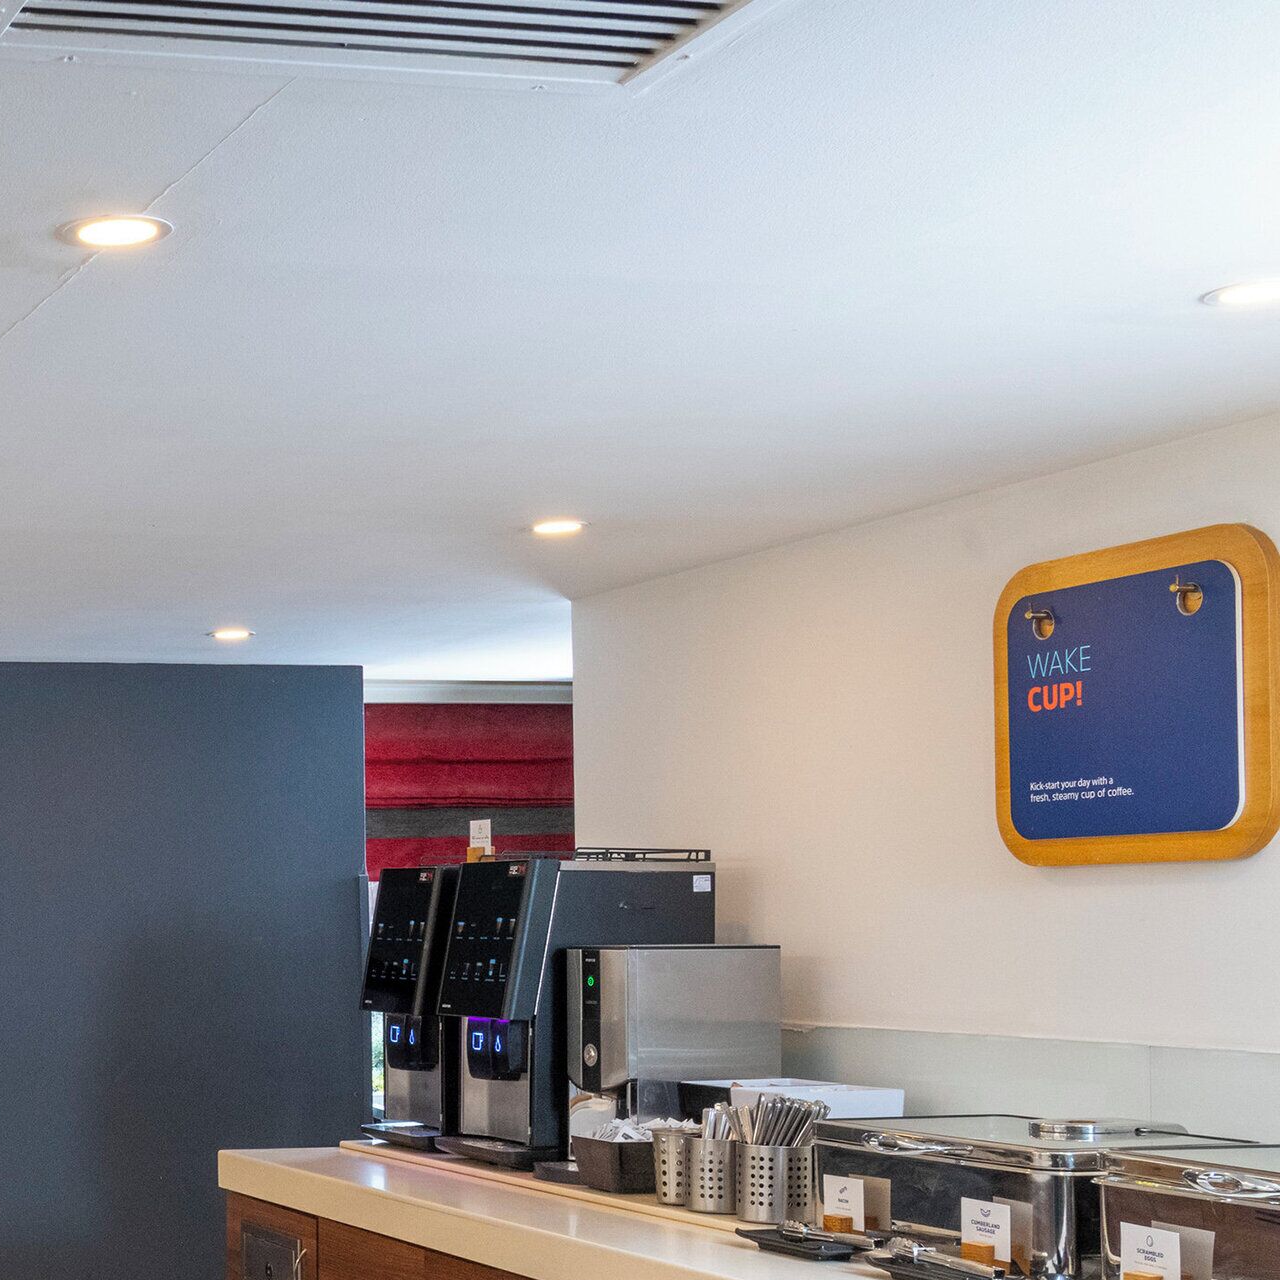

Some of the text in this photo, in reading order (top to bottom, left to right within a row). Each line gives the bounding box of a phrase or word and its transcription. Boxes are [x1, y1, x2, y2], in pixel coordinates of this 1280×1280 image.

[1026, 645, 1092, 679] WAKE
[1027, 680, 1083, 713] CUP!
[1029, 781, 1060, 791] Kick-start
[1060, 780, 1077, 791] your
[1077, 778, 1091, 789] day
[1091, 776, 1108, 786] with
[1051, 791, 1080, 802] steamy
[1080, 790, 1096, 800] cup
[1096, 788, 1106, 798] of
[1107, 787, 1135, 798] coffee.
[970, 1219, 1001, 1230] CUMBERLAND
[975, 1226, 996, 1235] SAUSAGE
[1136, 1248, 1164, 1258] SCRAMBLED
[1144, 1255, 1157, 1263] EGGS
